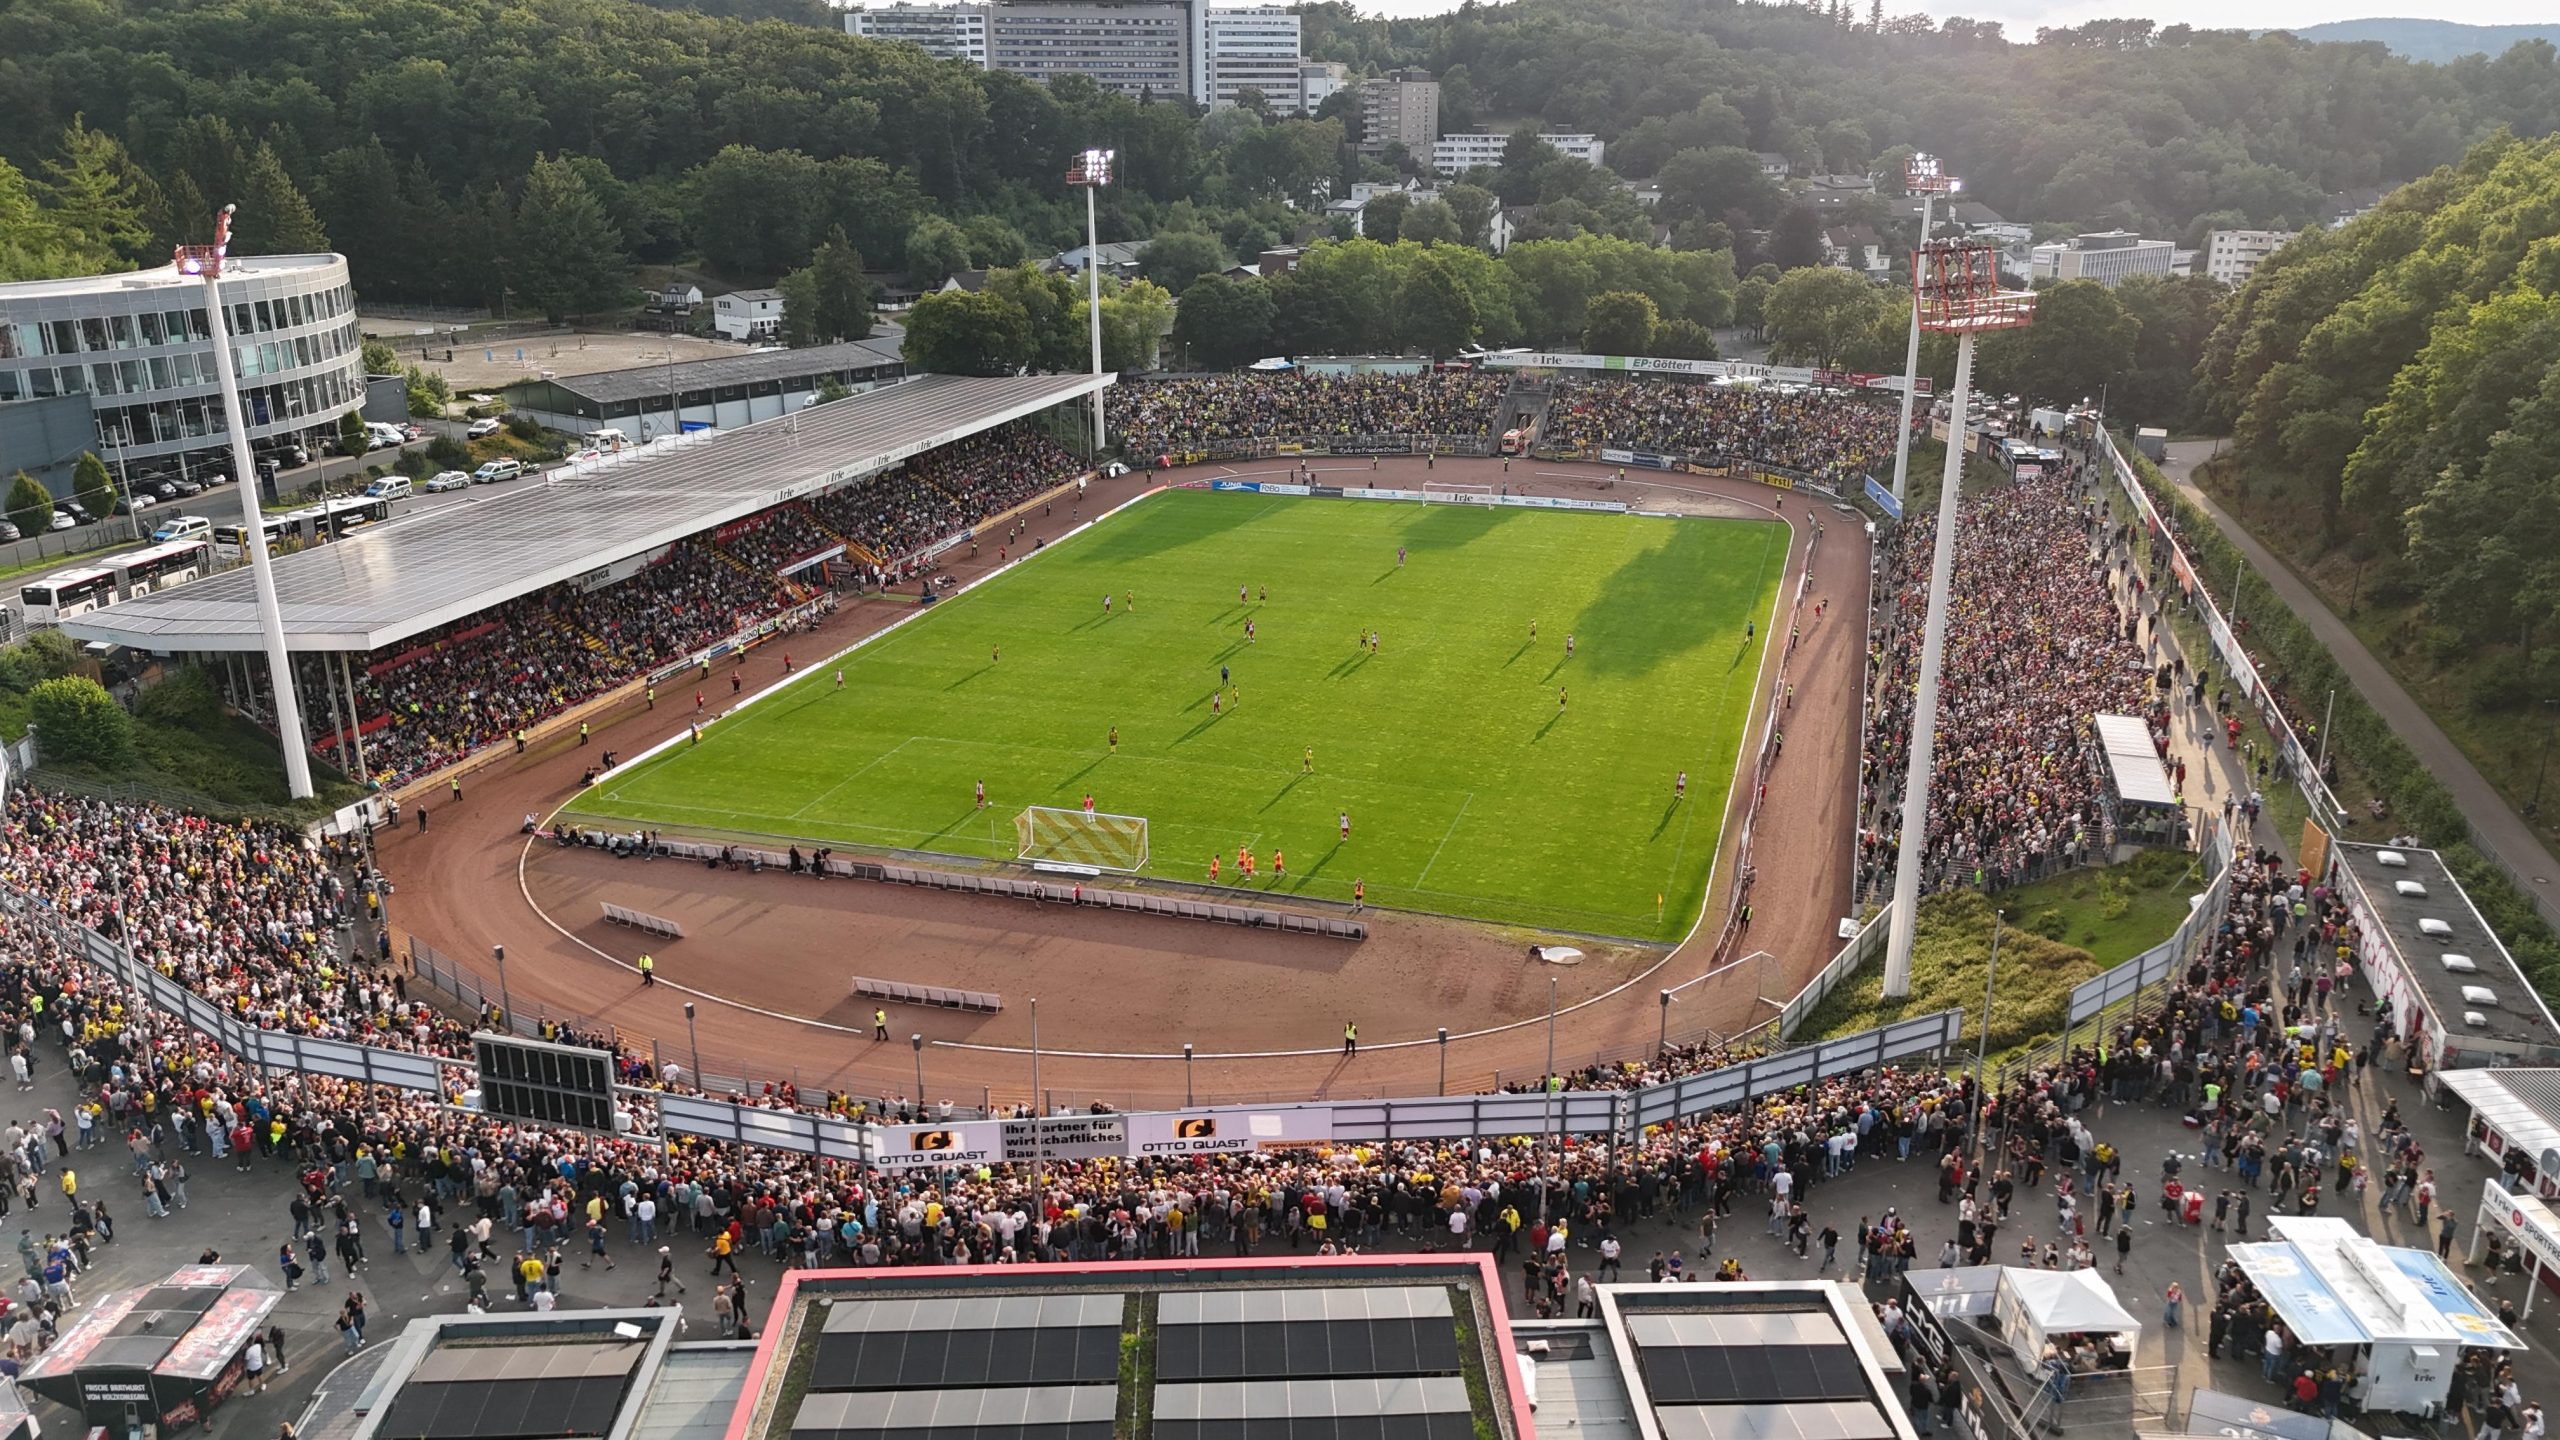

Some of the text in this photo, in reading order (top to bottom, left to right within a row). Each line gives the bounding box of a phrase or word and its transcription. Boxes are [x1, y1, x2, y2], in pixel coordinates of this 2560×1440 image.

[1541, 355, 1562, 365] Irle
[1632, 358, 1693, 370] EP:Göttert
[1750, 366, 1772, 377] Irle
[920, 439, 932, 451] Irle
[878, 454, 890, 467] Irle
[831, 469, 845, 483] Irle
[779, 487, 794, 501] Irle
[1454, 493, 1473, 502] Irle
[1006, 1124, 1026, 1134] Ihr
[1092, 1120, 1113, 1130] für
[1142, 1139, 1248, 1152] OTTO QUAST
[1264, 1141, 1325, 1149] www.quast.de
[879, 1150, 988, 1165] OTTO QUAST
[1006, 1149, 1056, 1159] Baun.
[2493, 1194, 2511, 1213] Irle
[2422, 1274, 2448, 1296] Irle
[2293, 1293, 2319, 1315] Irle
[2413, 1373, 2436, 1383] Irle
[84, 1384, 146, 1392] FRISCHE BRATWURST
[85, 1393, 150, 1401] VOM HOLZKOHLEGRILL
